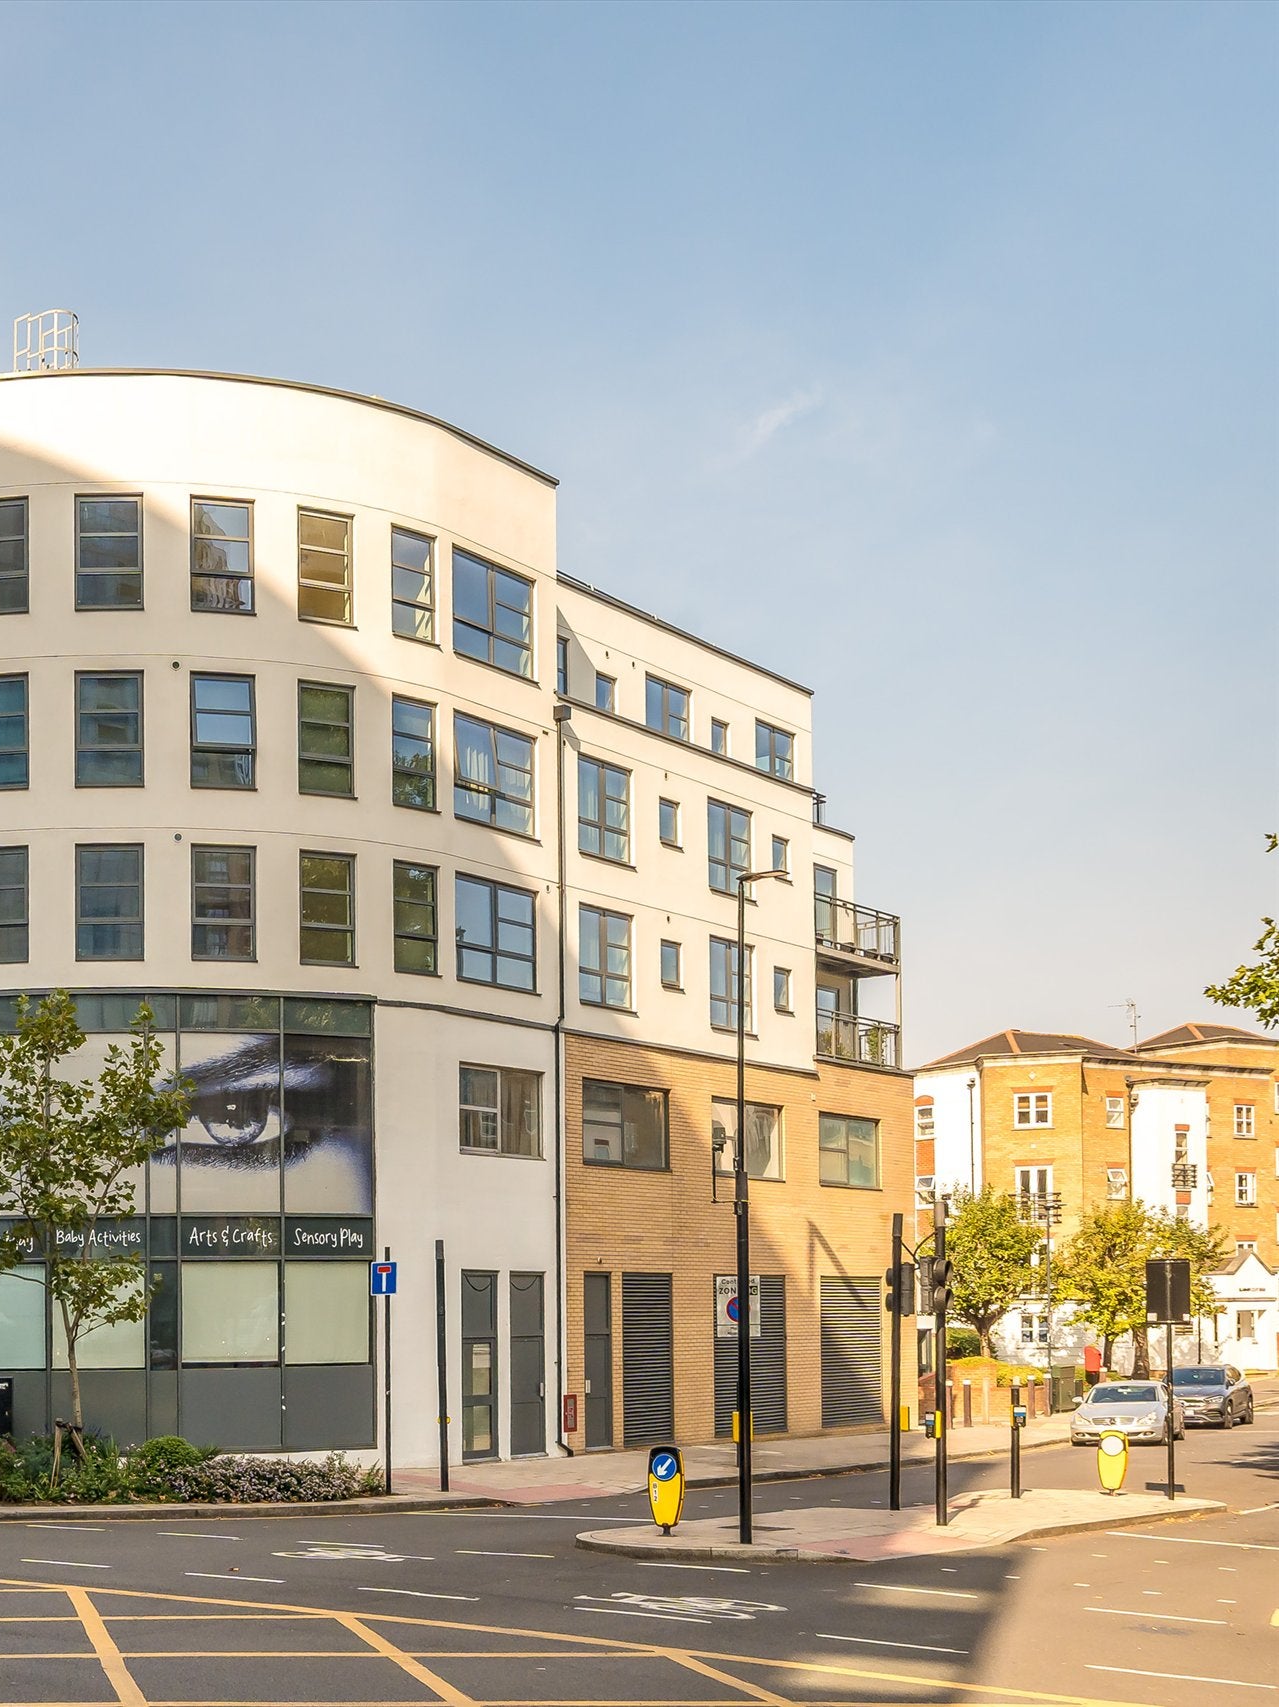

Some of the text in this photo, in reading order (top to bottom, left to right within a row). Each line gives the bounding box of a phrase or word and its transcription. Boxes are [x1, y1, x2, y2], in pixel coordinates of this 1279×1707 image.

[56, 1227, 141, 1247] Baby Activities
[189, 1225, 273, 1248] Arts & Crafts
[293, 1227, 363, 1249] Sensory Play
[719, 1287, 737, 1295] ZON
